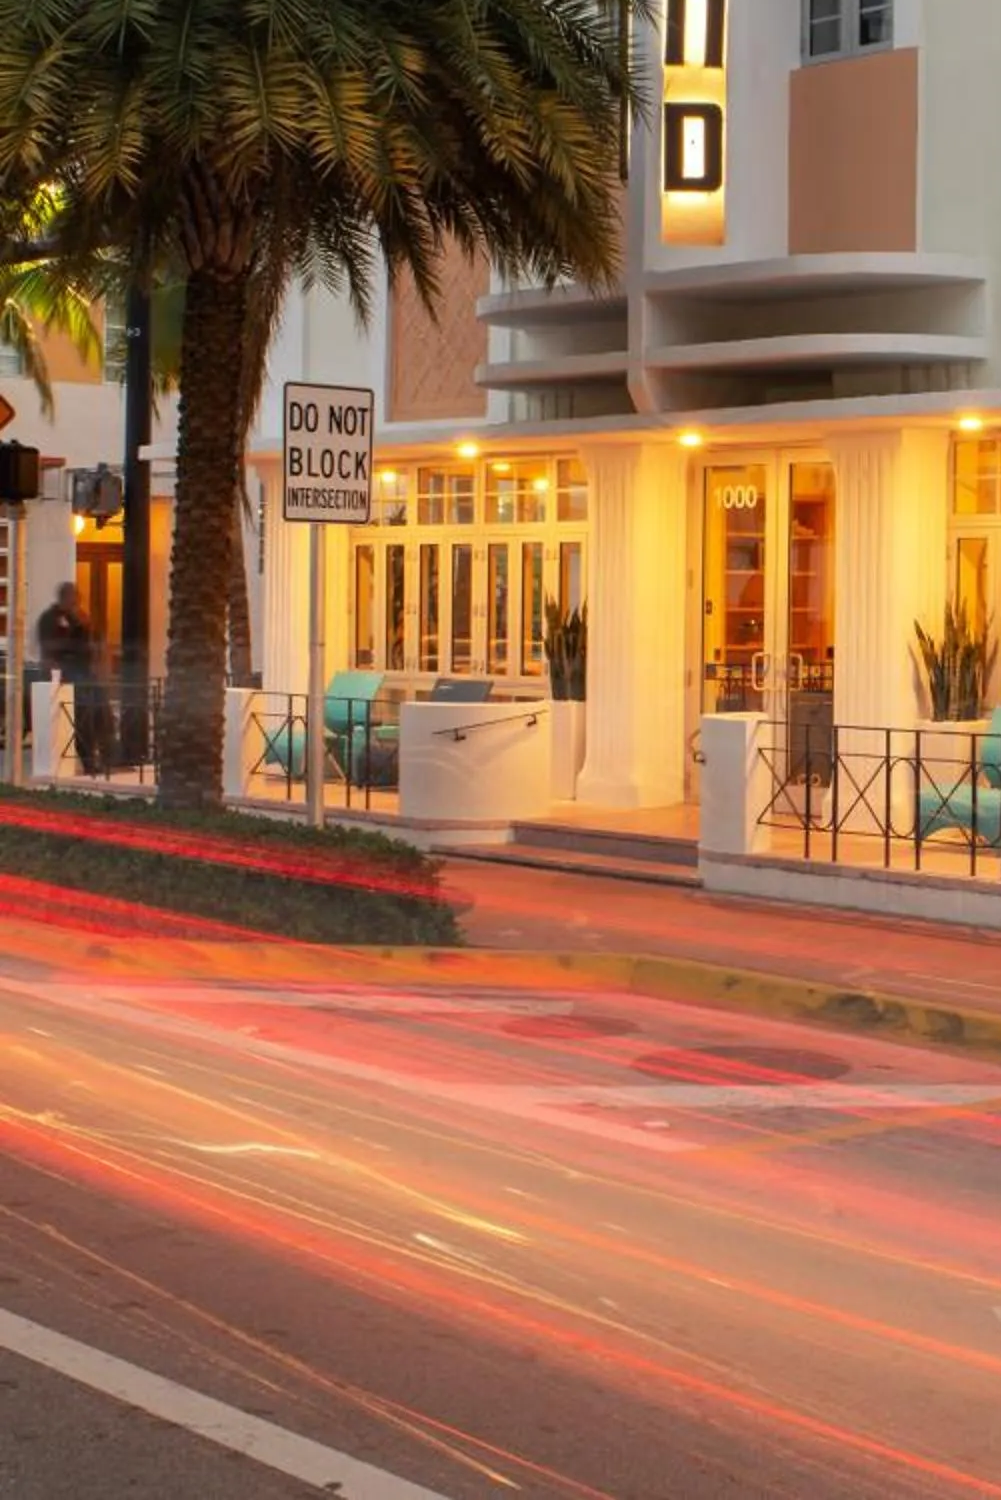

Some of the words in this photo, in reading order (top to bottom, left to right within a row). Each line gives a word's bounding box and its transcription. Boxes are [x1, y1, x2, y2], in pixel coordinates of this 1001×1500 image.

[289, 401, 319, 433] DO
[328, 405, 369, 436] NOT
[289, 446, 367, 481] BLOCK
[287, 486, 367, 511] INTERSECTION
[713, 485, 757, 509] 1000
